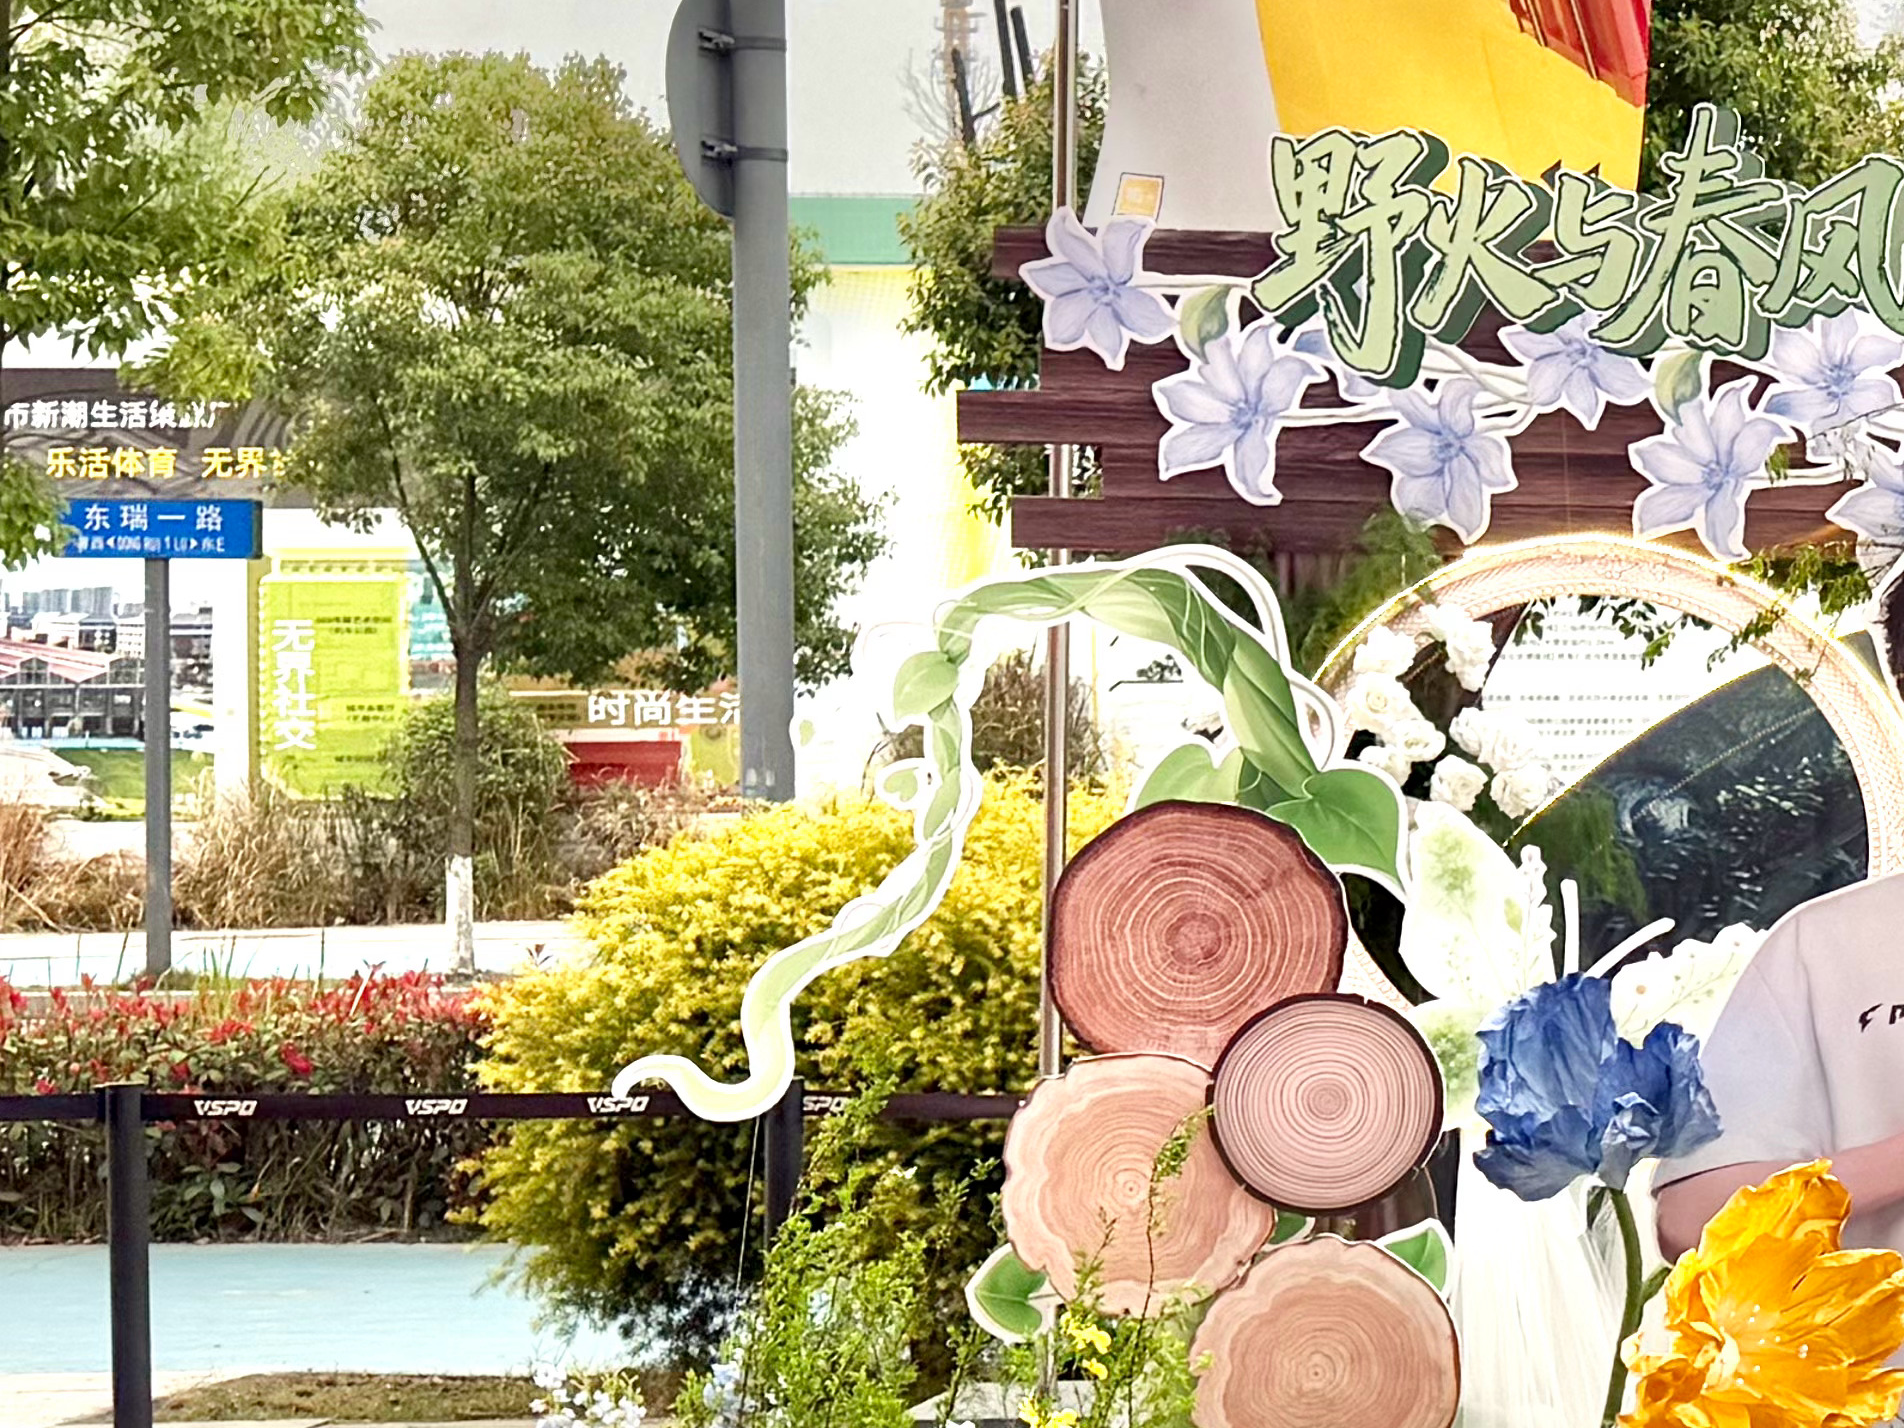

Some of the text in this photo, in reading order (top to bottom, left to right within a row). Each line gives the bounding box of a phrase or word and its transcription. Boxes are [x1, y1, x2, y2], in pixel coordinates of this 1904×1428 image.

[45, 446, 178, 480] 乐活体育
[83, 503, 223, 532] 东瑞一路
[271, 619, 317, 752] 无界社交
[194, 1098, 258, 1118] VSPO
[404, 1097, 469, 1117] VSPO
[586, 1095, 650, 1114] VSPO
